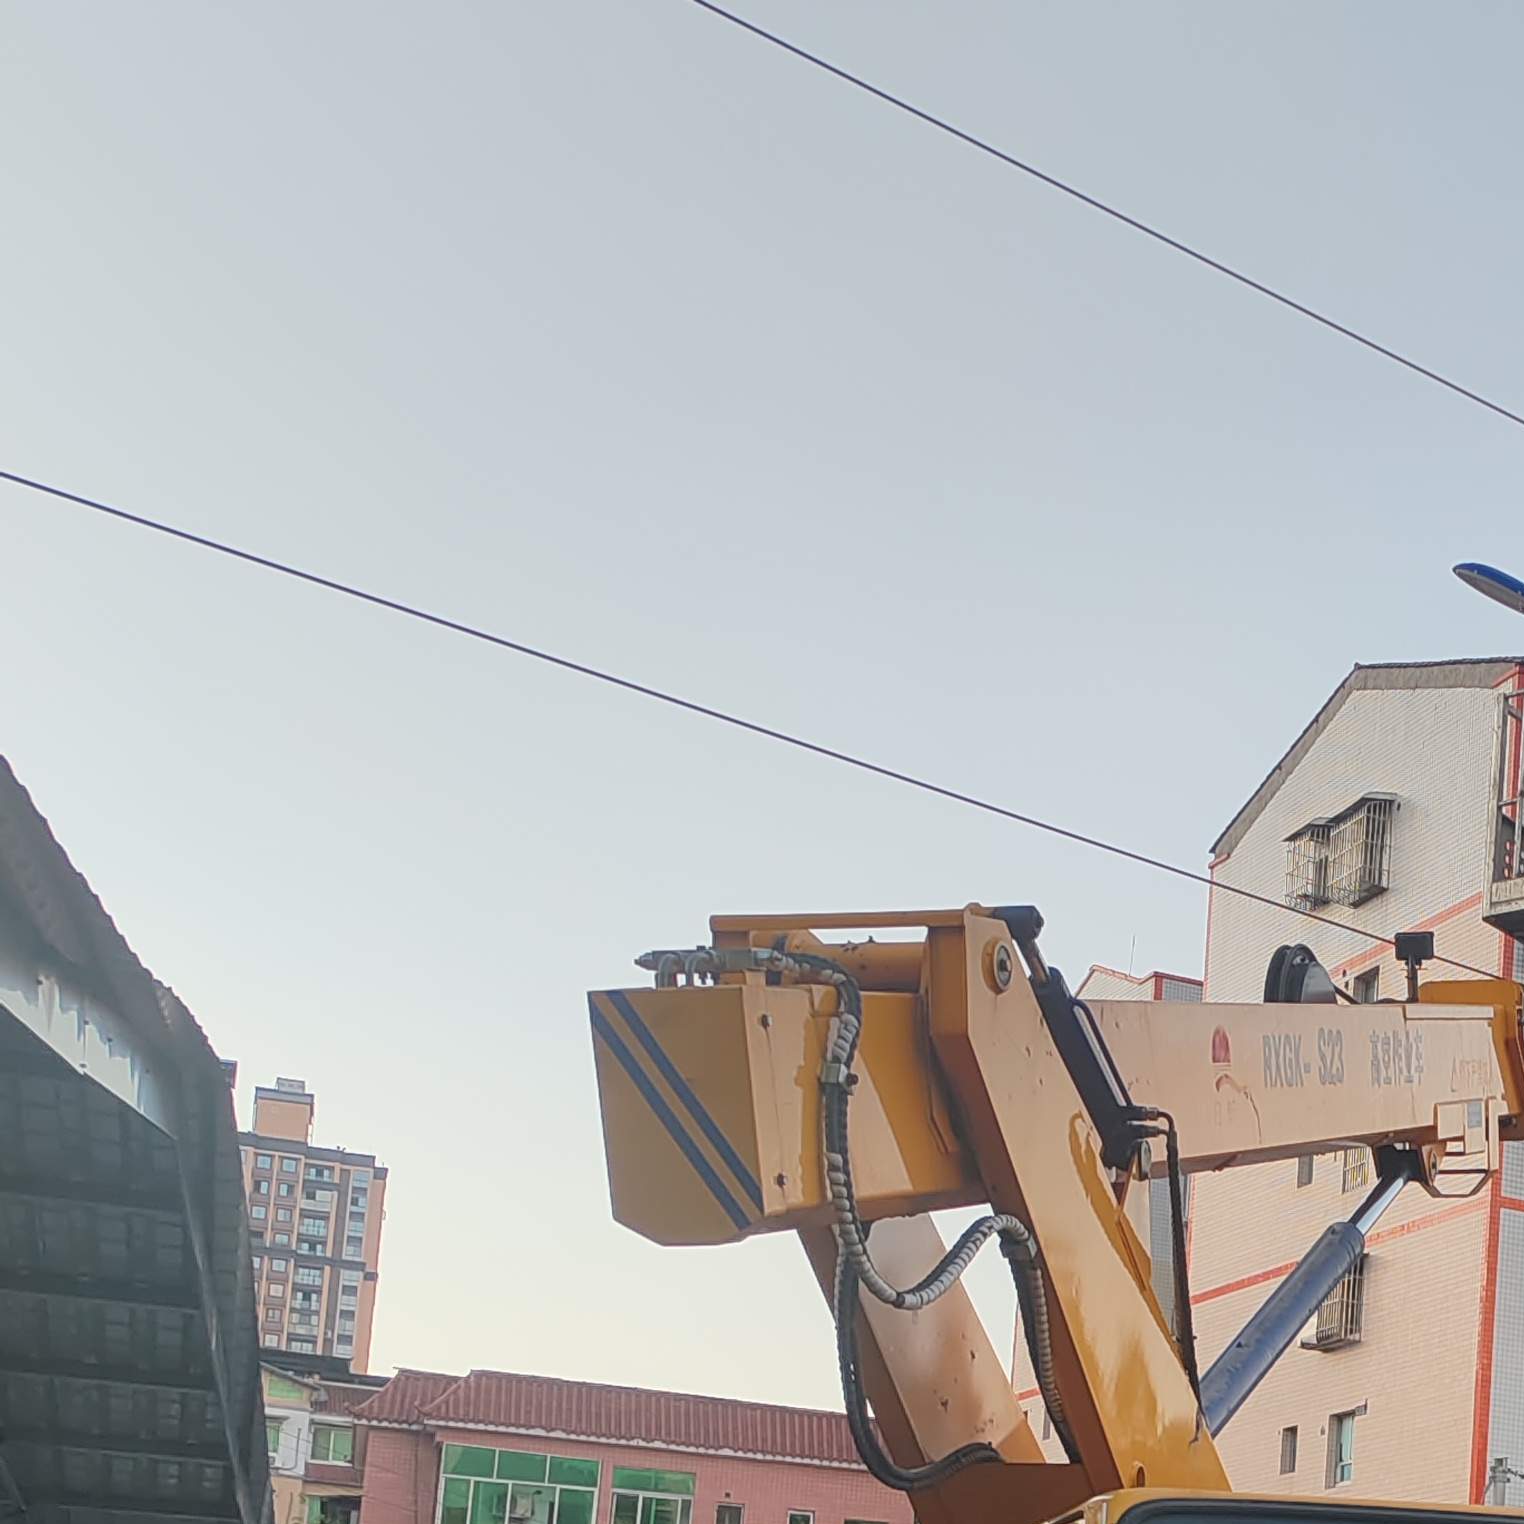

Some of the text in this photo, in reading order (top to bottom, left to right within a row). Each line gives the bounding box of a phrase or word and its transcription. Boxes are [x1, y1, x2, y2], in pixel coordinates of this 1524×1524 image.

[1317, 1027, 1345, 1086] S23
[1369, 1028, 1424, 1088] 高空作业车
